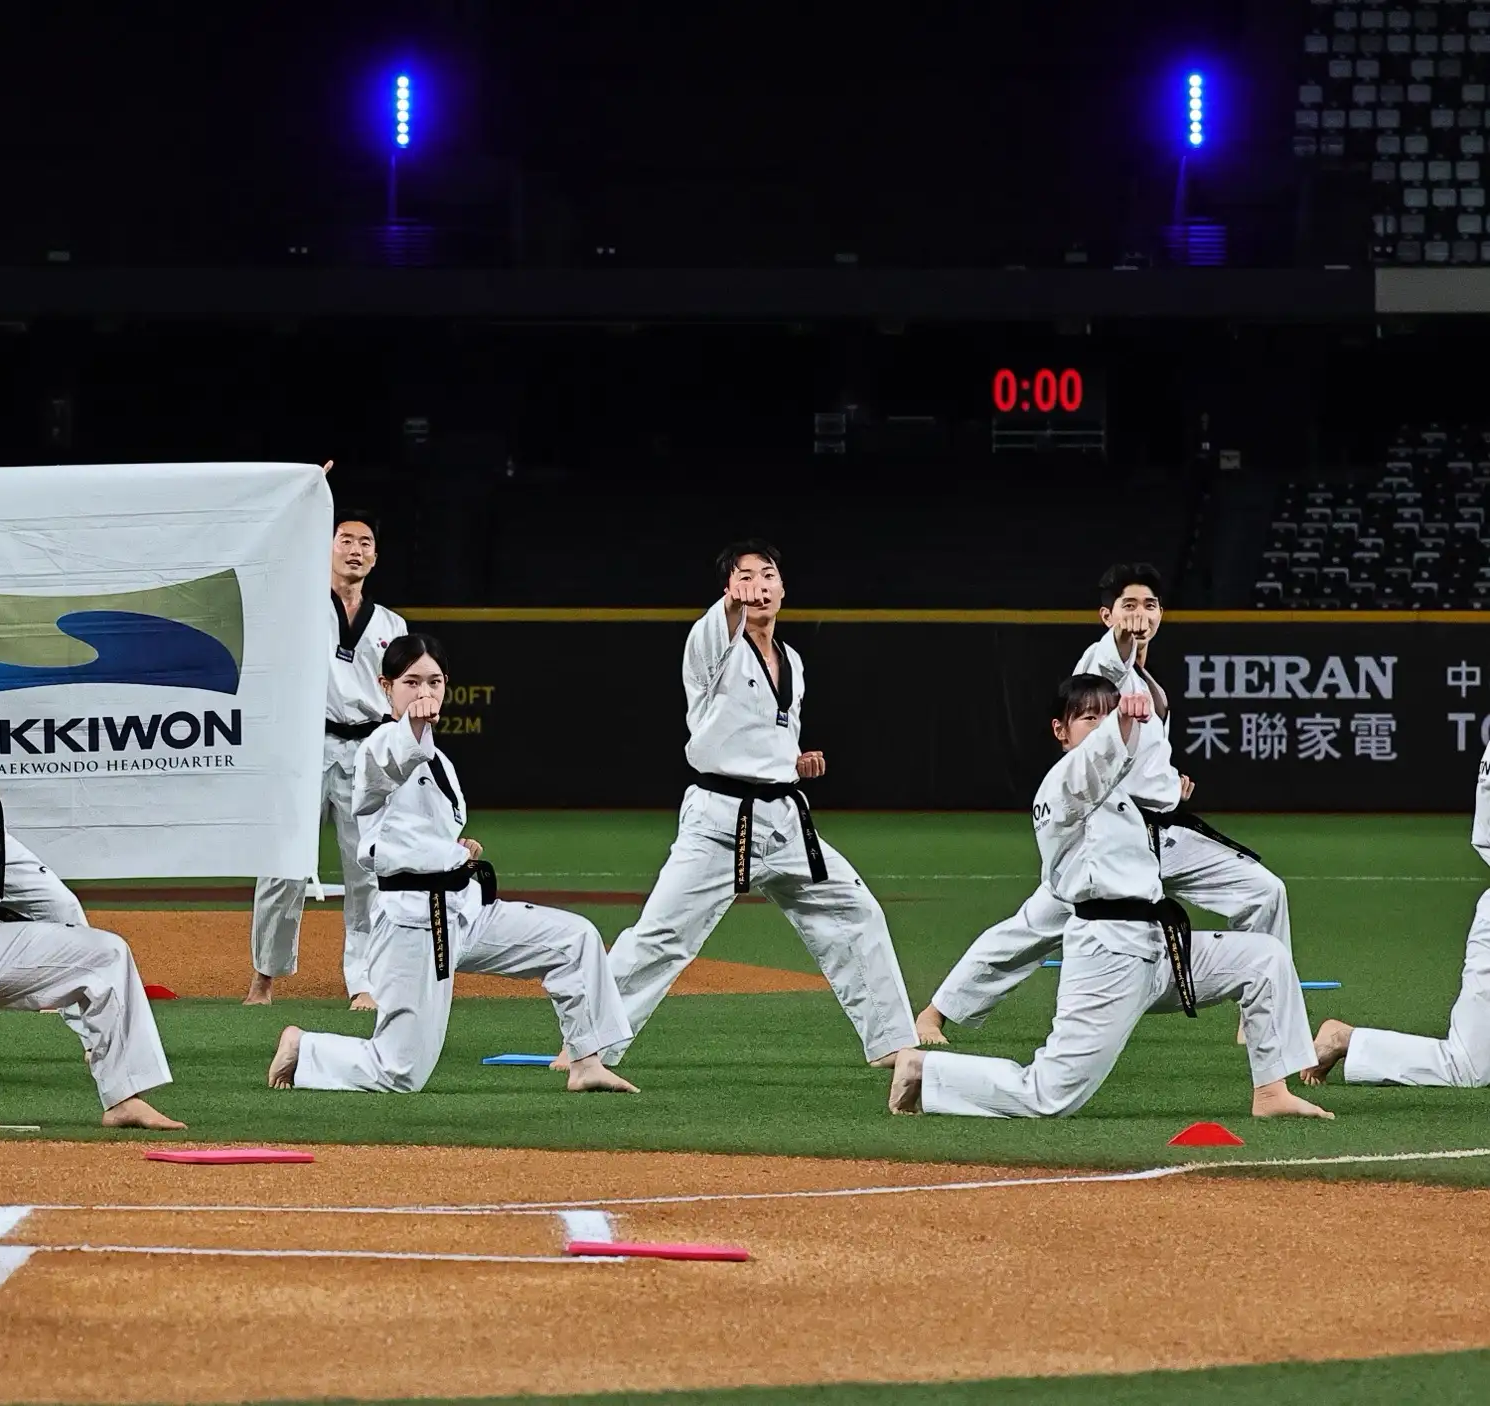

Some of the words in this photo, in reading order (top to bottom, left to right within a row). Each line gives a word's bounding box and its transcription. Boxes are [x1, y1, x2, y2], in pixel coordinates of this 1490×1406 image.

[993, 368, 1083, 412] 0:00
[443, 685, 496, 705] 00FT
[1184, 655, 1398, 699] HERAN
[439, 716, 481, 734] 22M
[1185, 712, 1398, 761] 禾聯家電
[1448, 712, 1490, 751] T
[107, 755, 235, 773] HEADQUARTER
